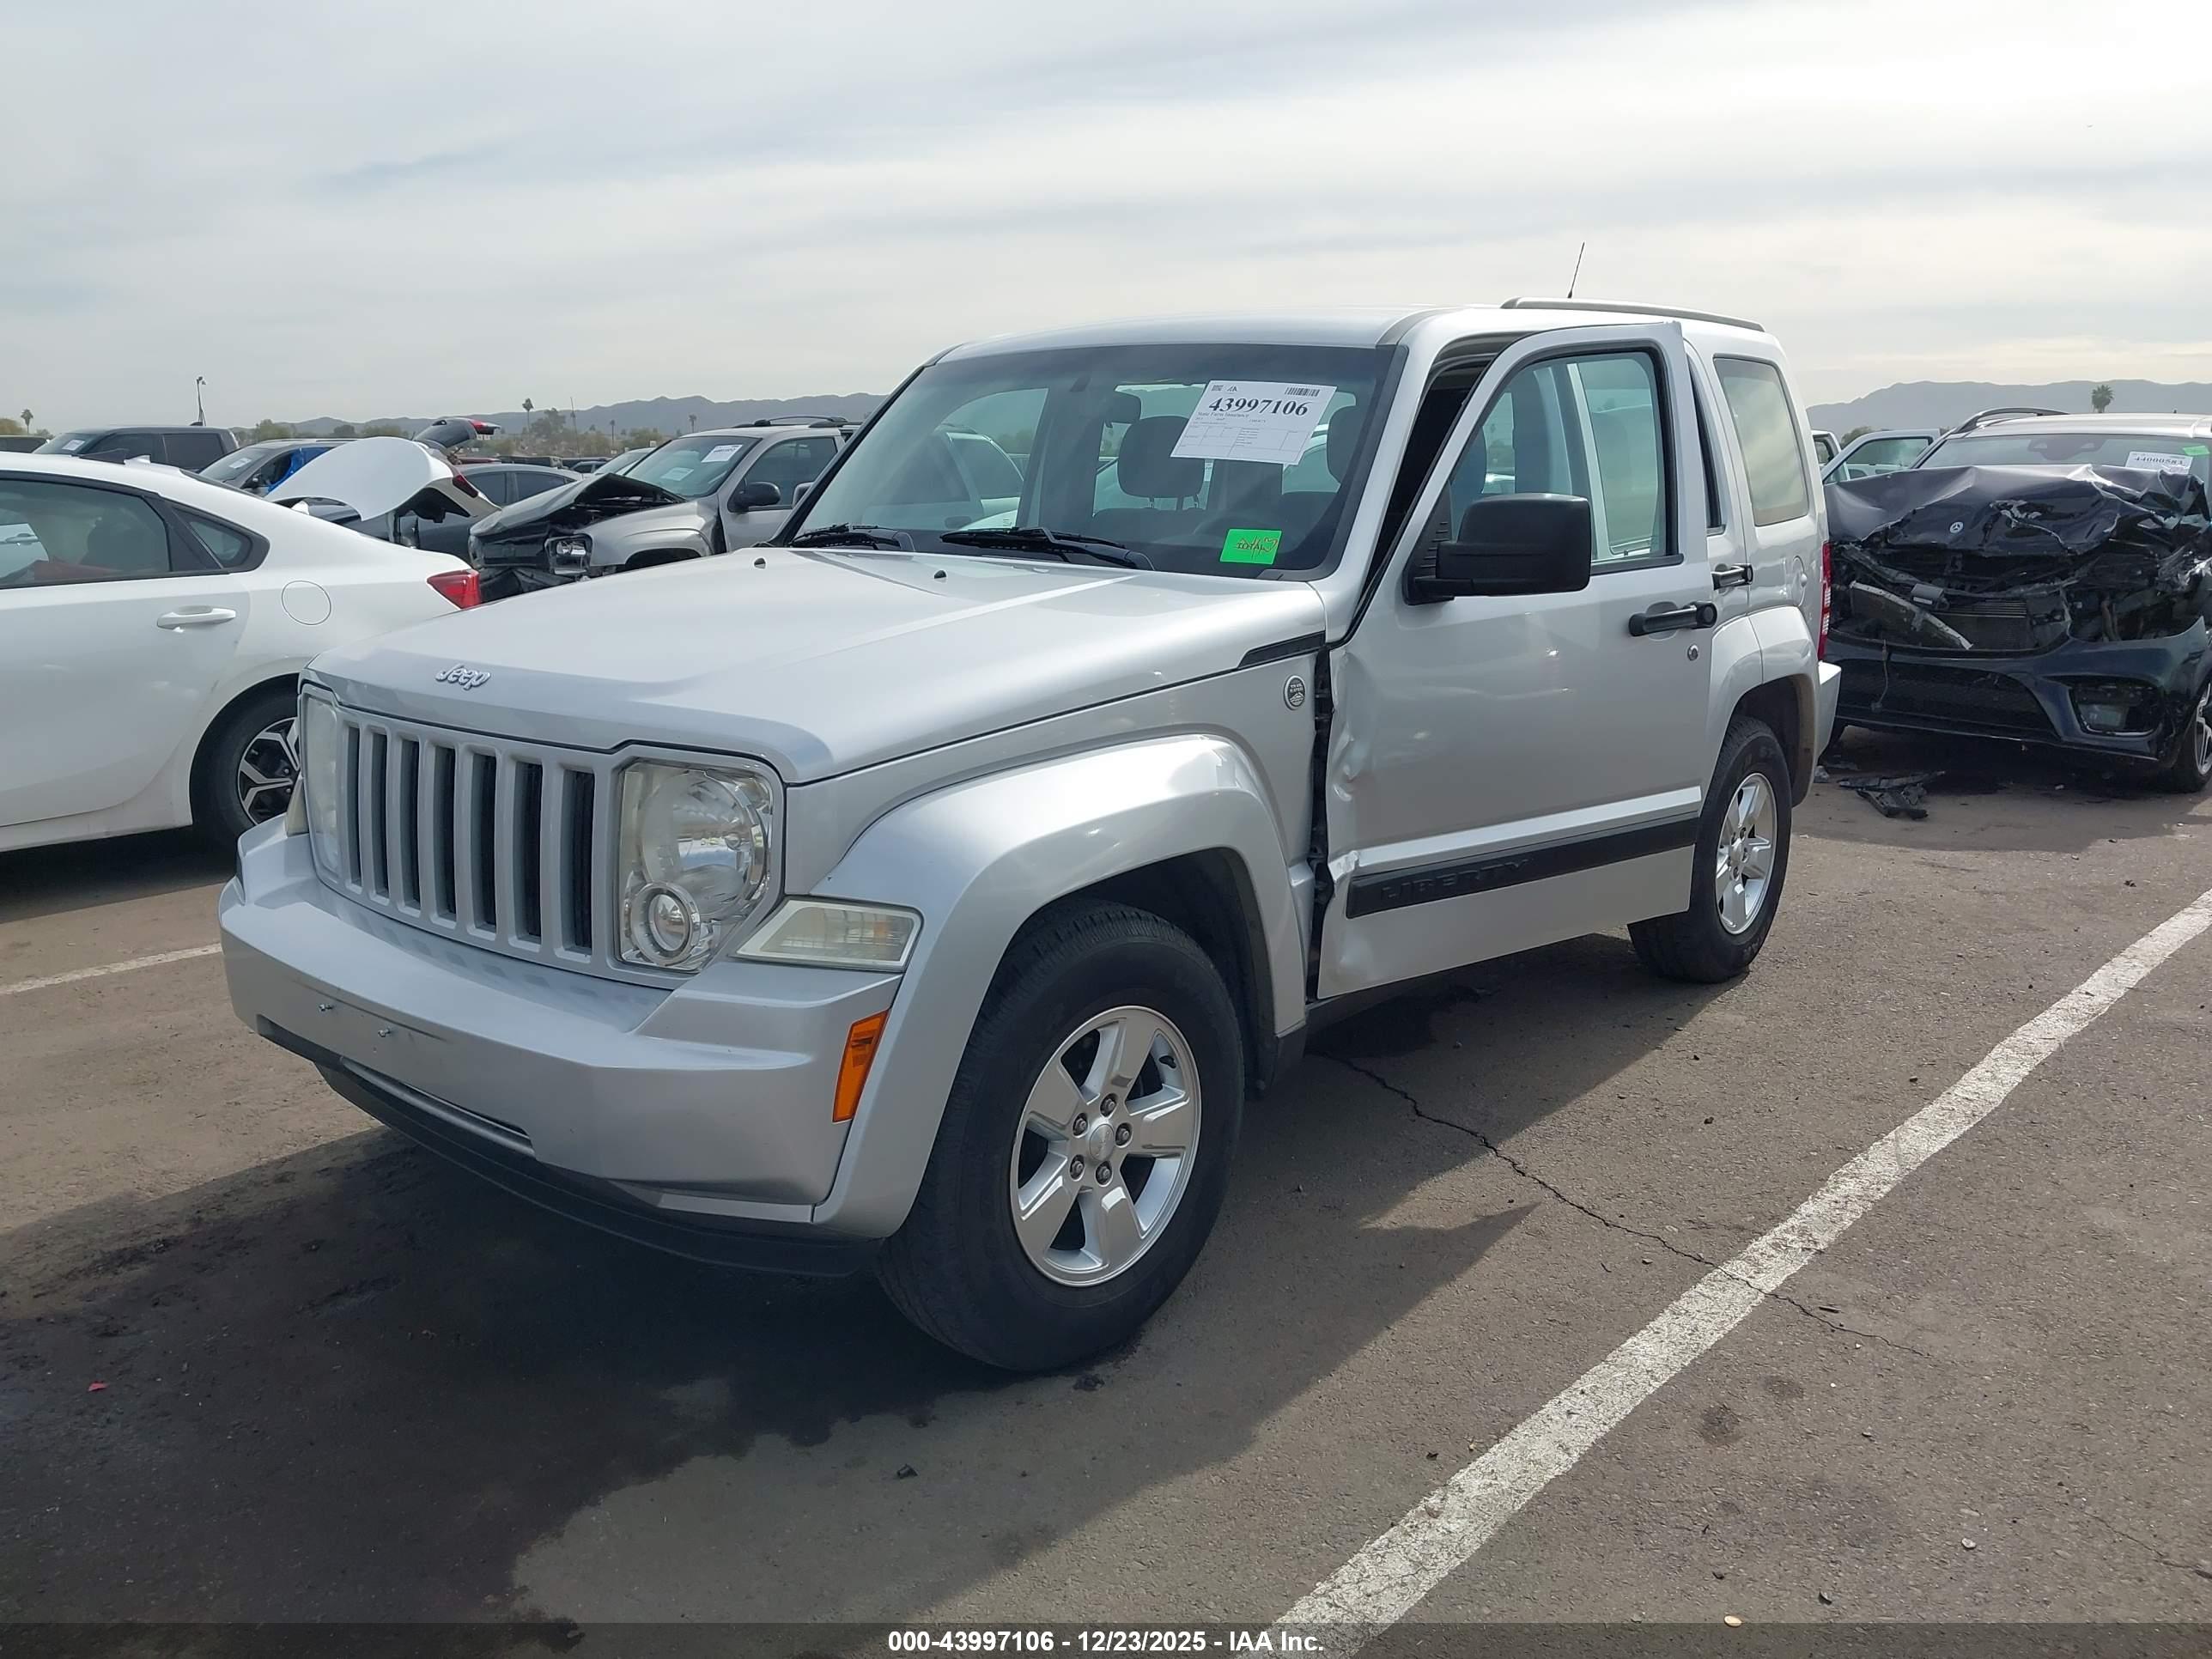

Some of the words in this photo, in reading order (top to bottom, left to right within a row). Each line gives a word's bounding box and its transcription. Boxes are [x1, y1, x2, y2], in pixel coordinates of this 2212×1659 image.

[1208, 397, 1313, 416] 43997106
[435, 664, 490, 690] Jeep
[1381, 858, 1534, 899] LIBERTY
